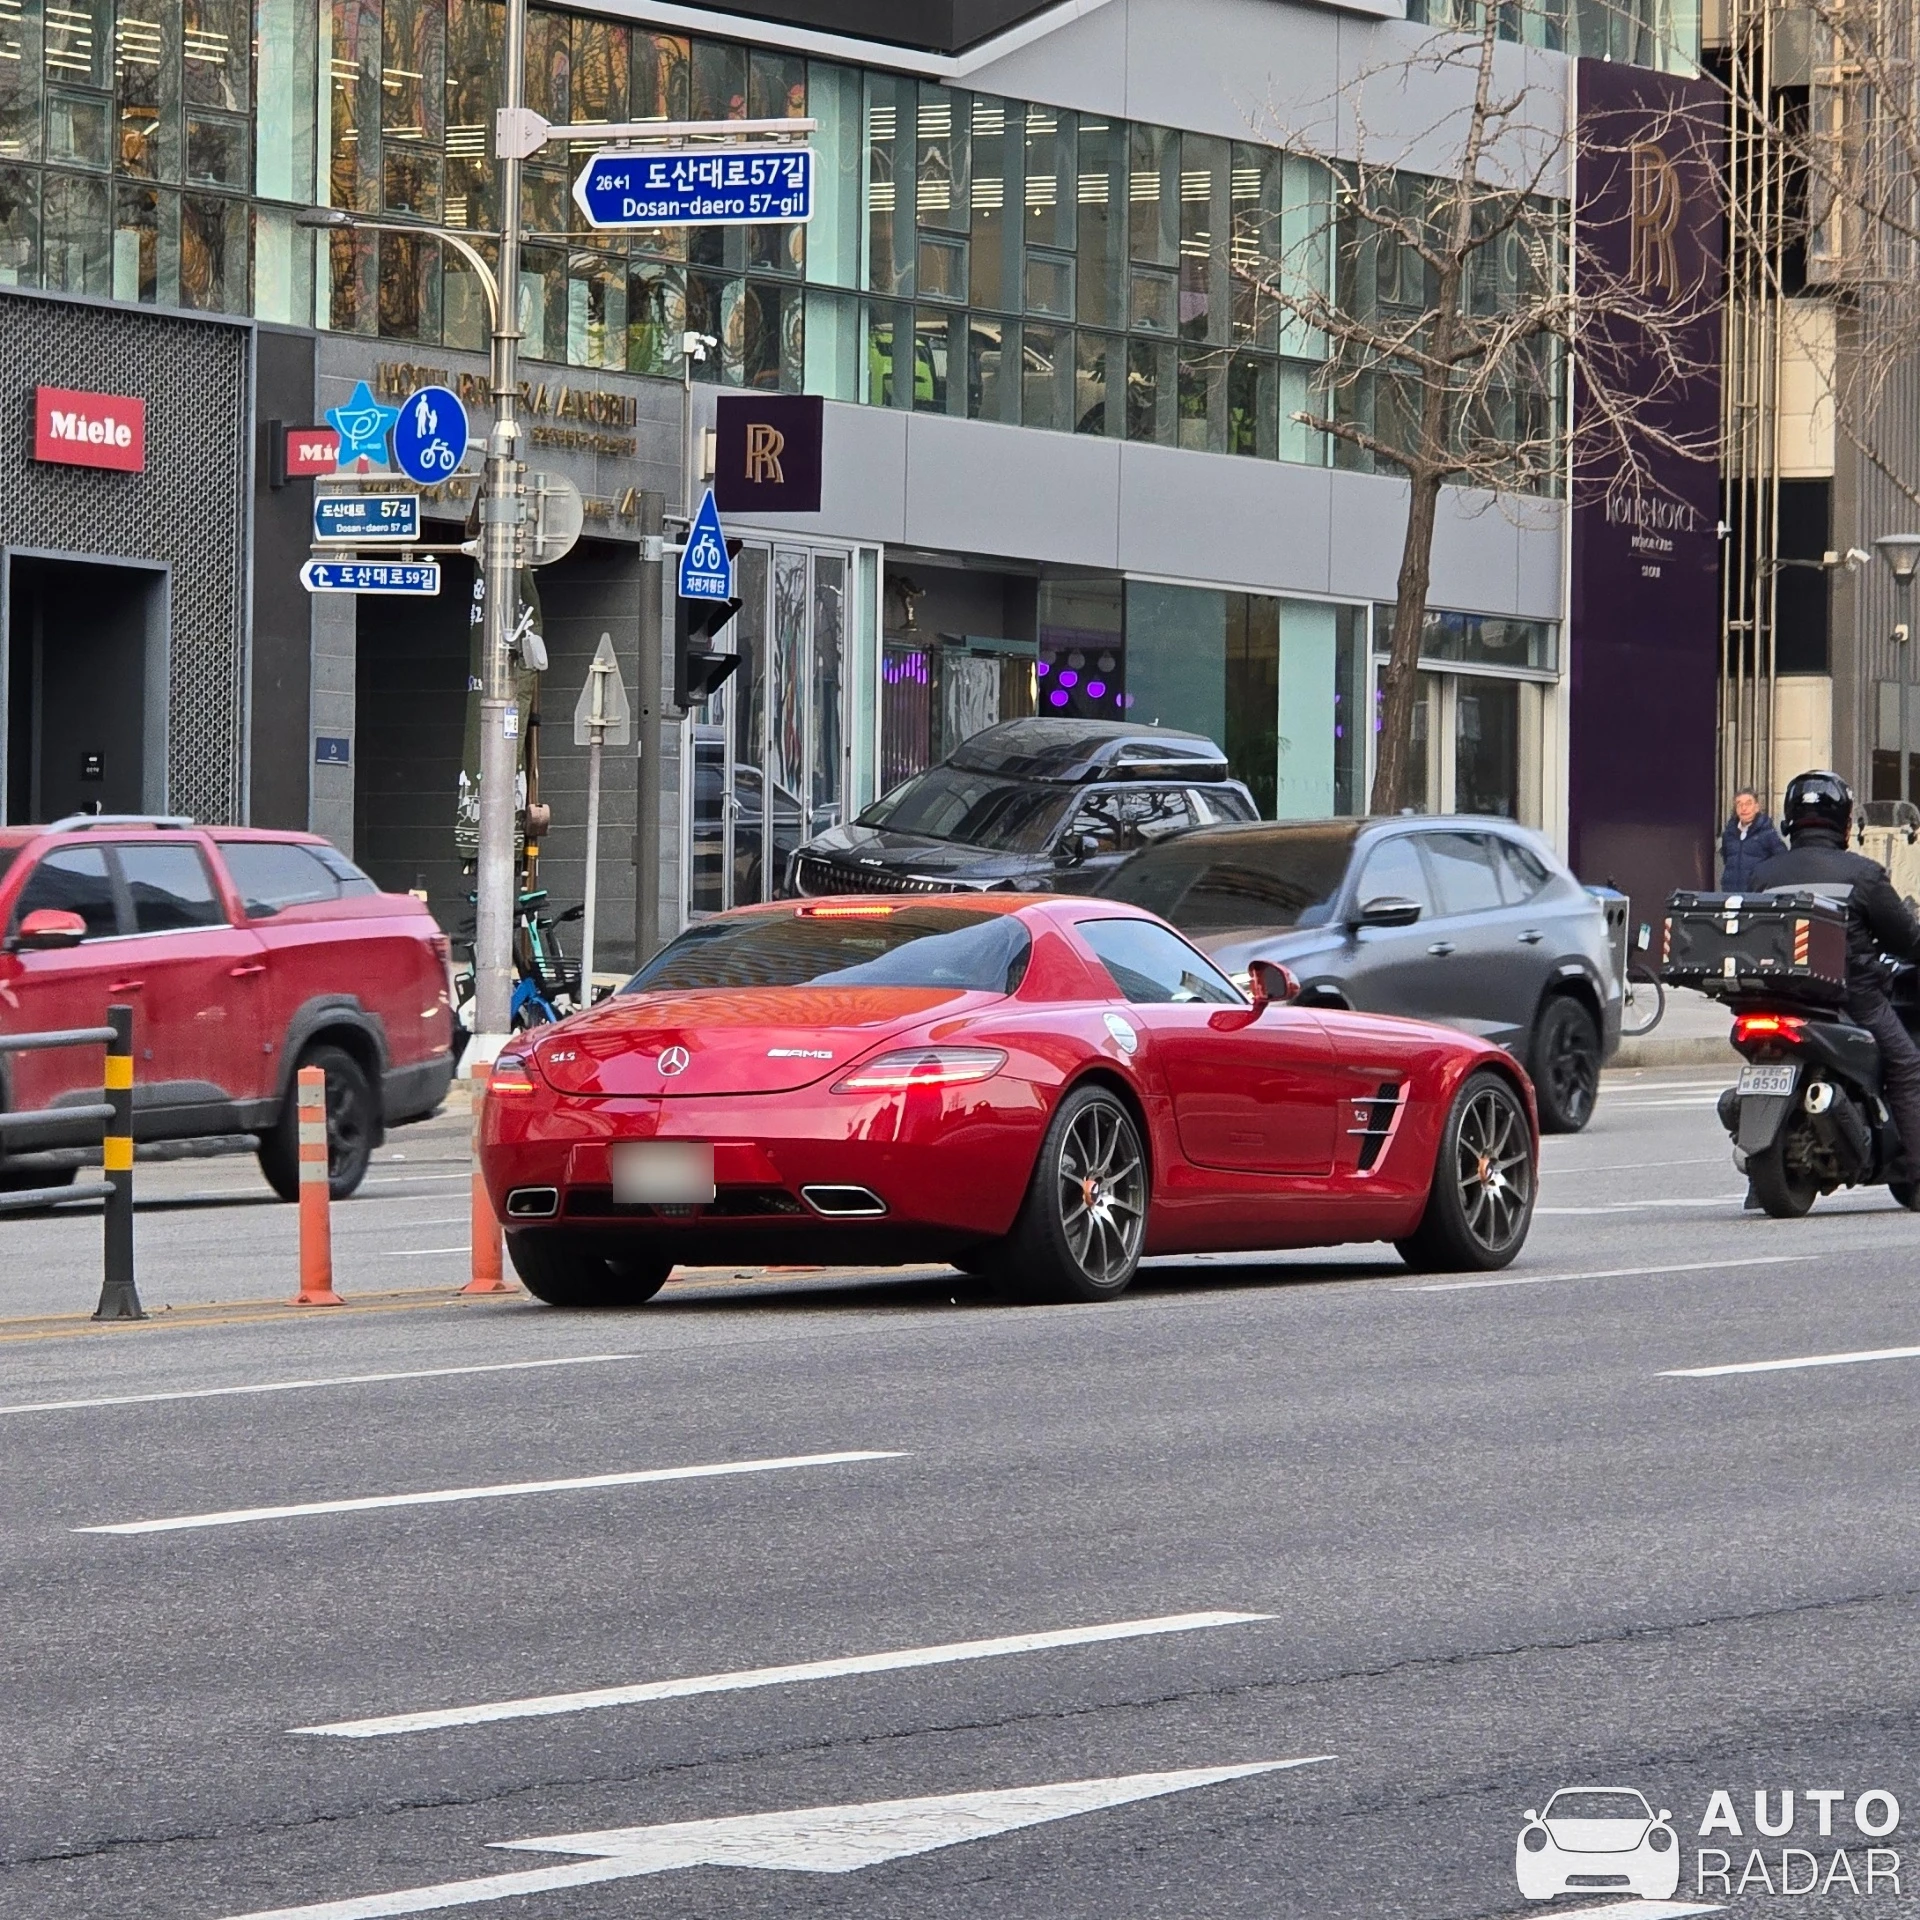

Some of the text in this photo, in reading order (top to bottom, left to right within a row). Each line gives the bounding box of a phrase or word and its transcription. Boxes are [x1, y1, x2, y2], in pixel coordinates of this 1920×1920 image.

[644, 156, 804, 192] 도산대로57길
[622, 192, 804, 217] Dosan-daero 57-gil
[50, 410, 132, 448] Miele
[321, 501, 411, 518] 도산대로 57길
[390, 523, 400, 532] 57
[402, 523, 412, 533] gil
[340, 567, 434, 589] 도산대로59길
[550, 1049, 833, 1063] SLS AMG
[1752, 1077, 1788, 1090] 8530
